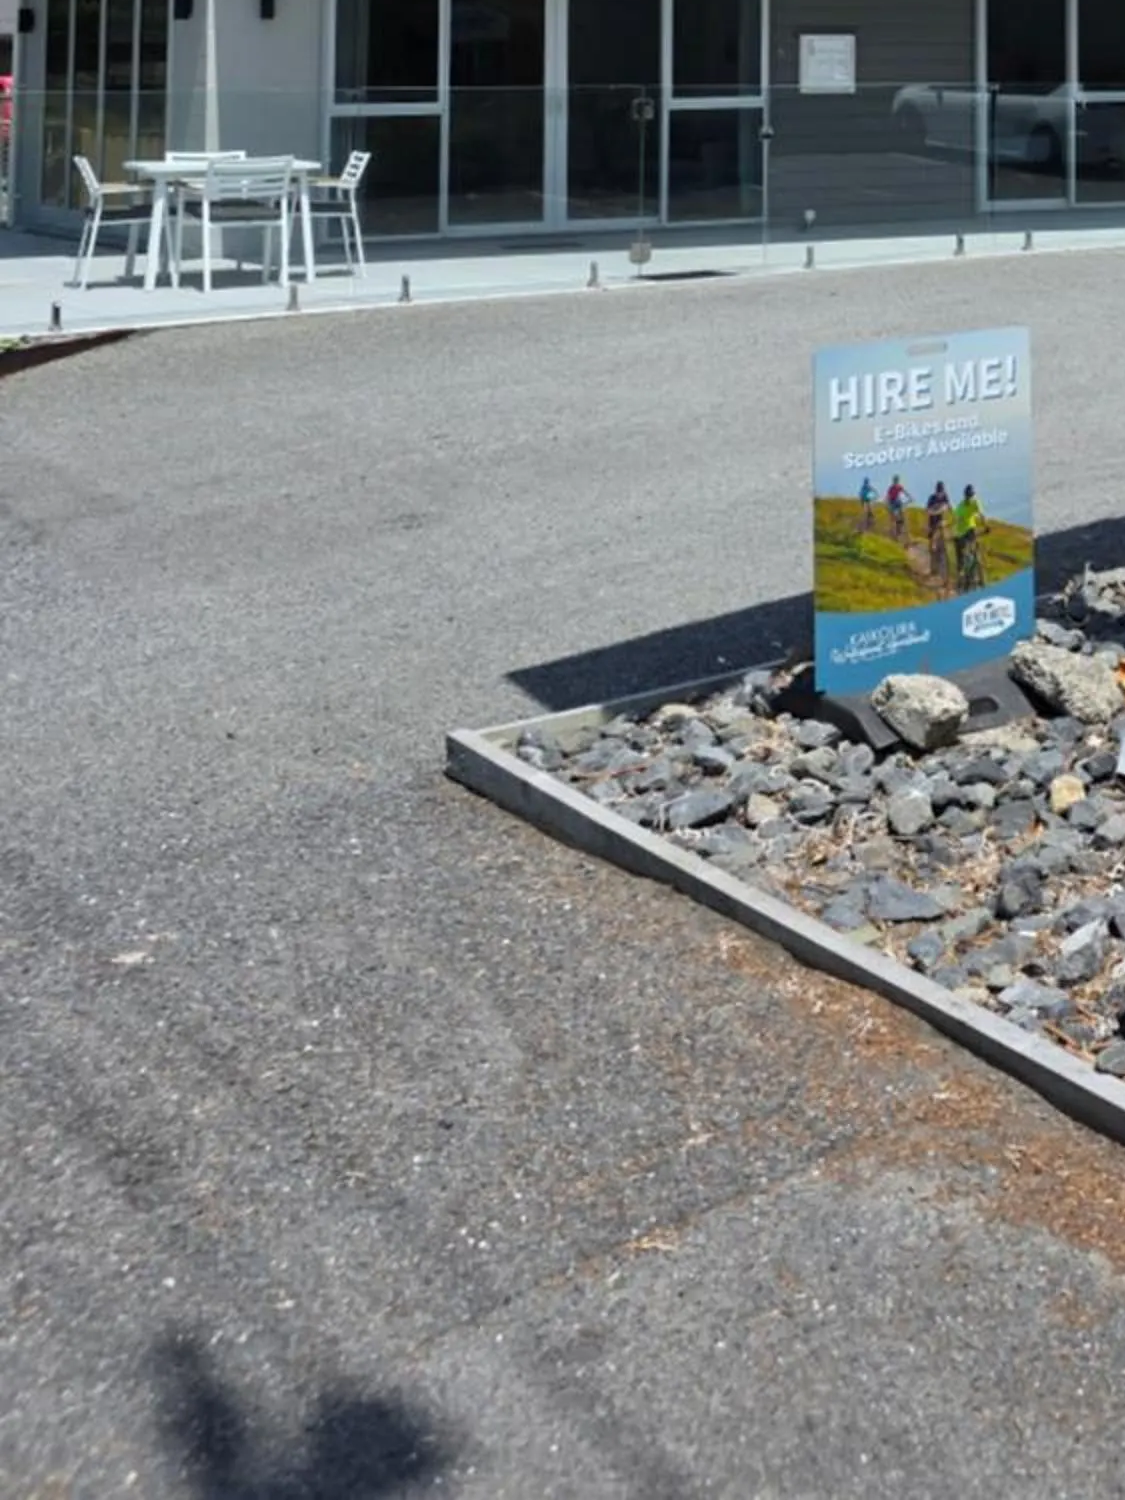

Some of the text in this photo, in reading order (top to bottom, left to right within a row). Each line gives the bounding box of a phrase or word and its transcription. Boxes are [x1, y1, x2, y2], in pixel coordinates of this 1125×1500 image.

[830, 355, 1018, 422] HIRE ME!
[843, 428, 1009, 469] Scooters Available
[873, 414, 980, 444] E-Bikes and
